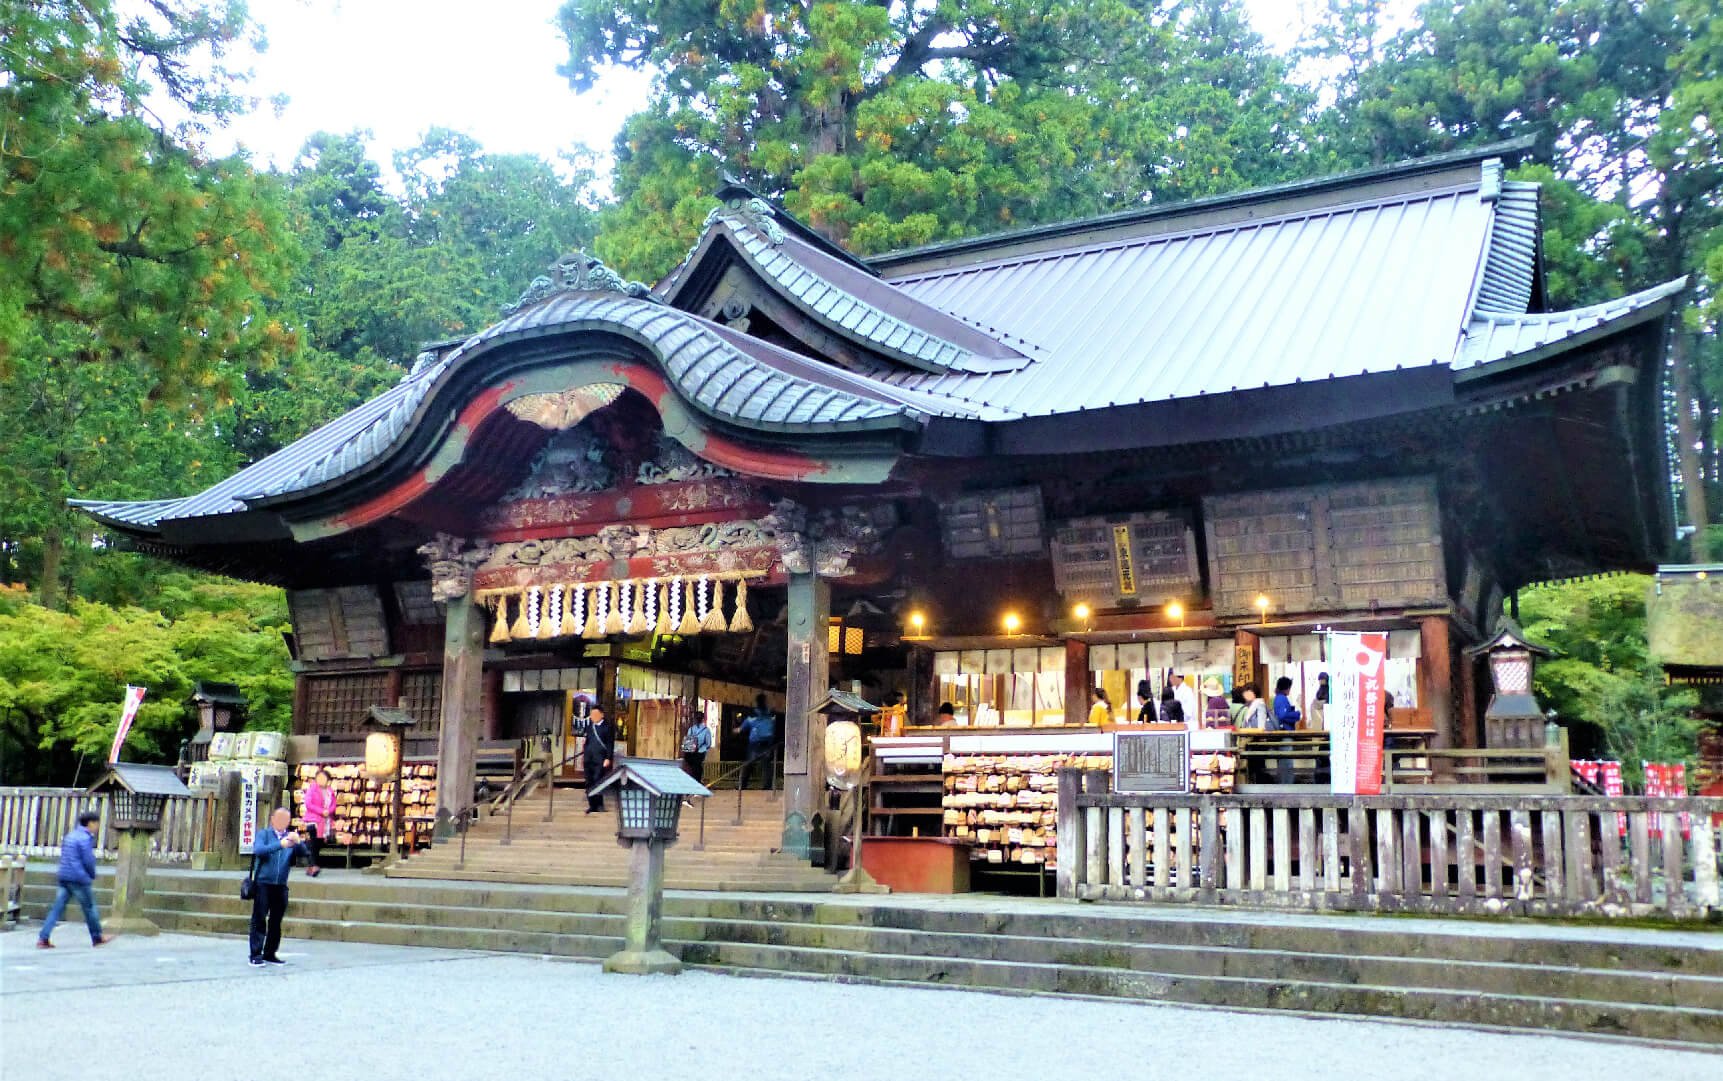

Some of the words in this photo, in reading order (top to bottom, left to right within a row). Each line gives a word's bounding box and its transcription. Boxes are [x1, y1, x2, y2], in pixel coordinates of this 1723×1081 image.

[1238, 647, 1251, 684] 御朱印
[1365, 679, 1380, 737] 祝祭日には
